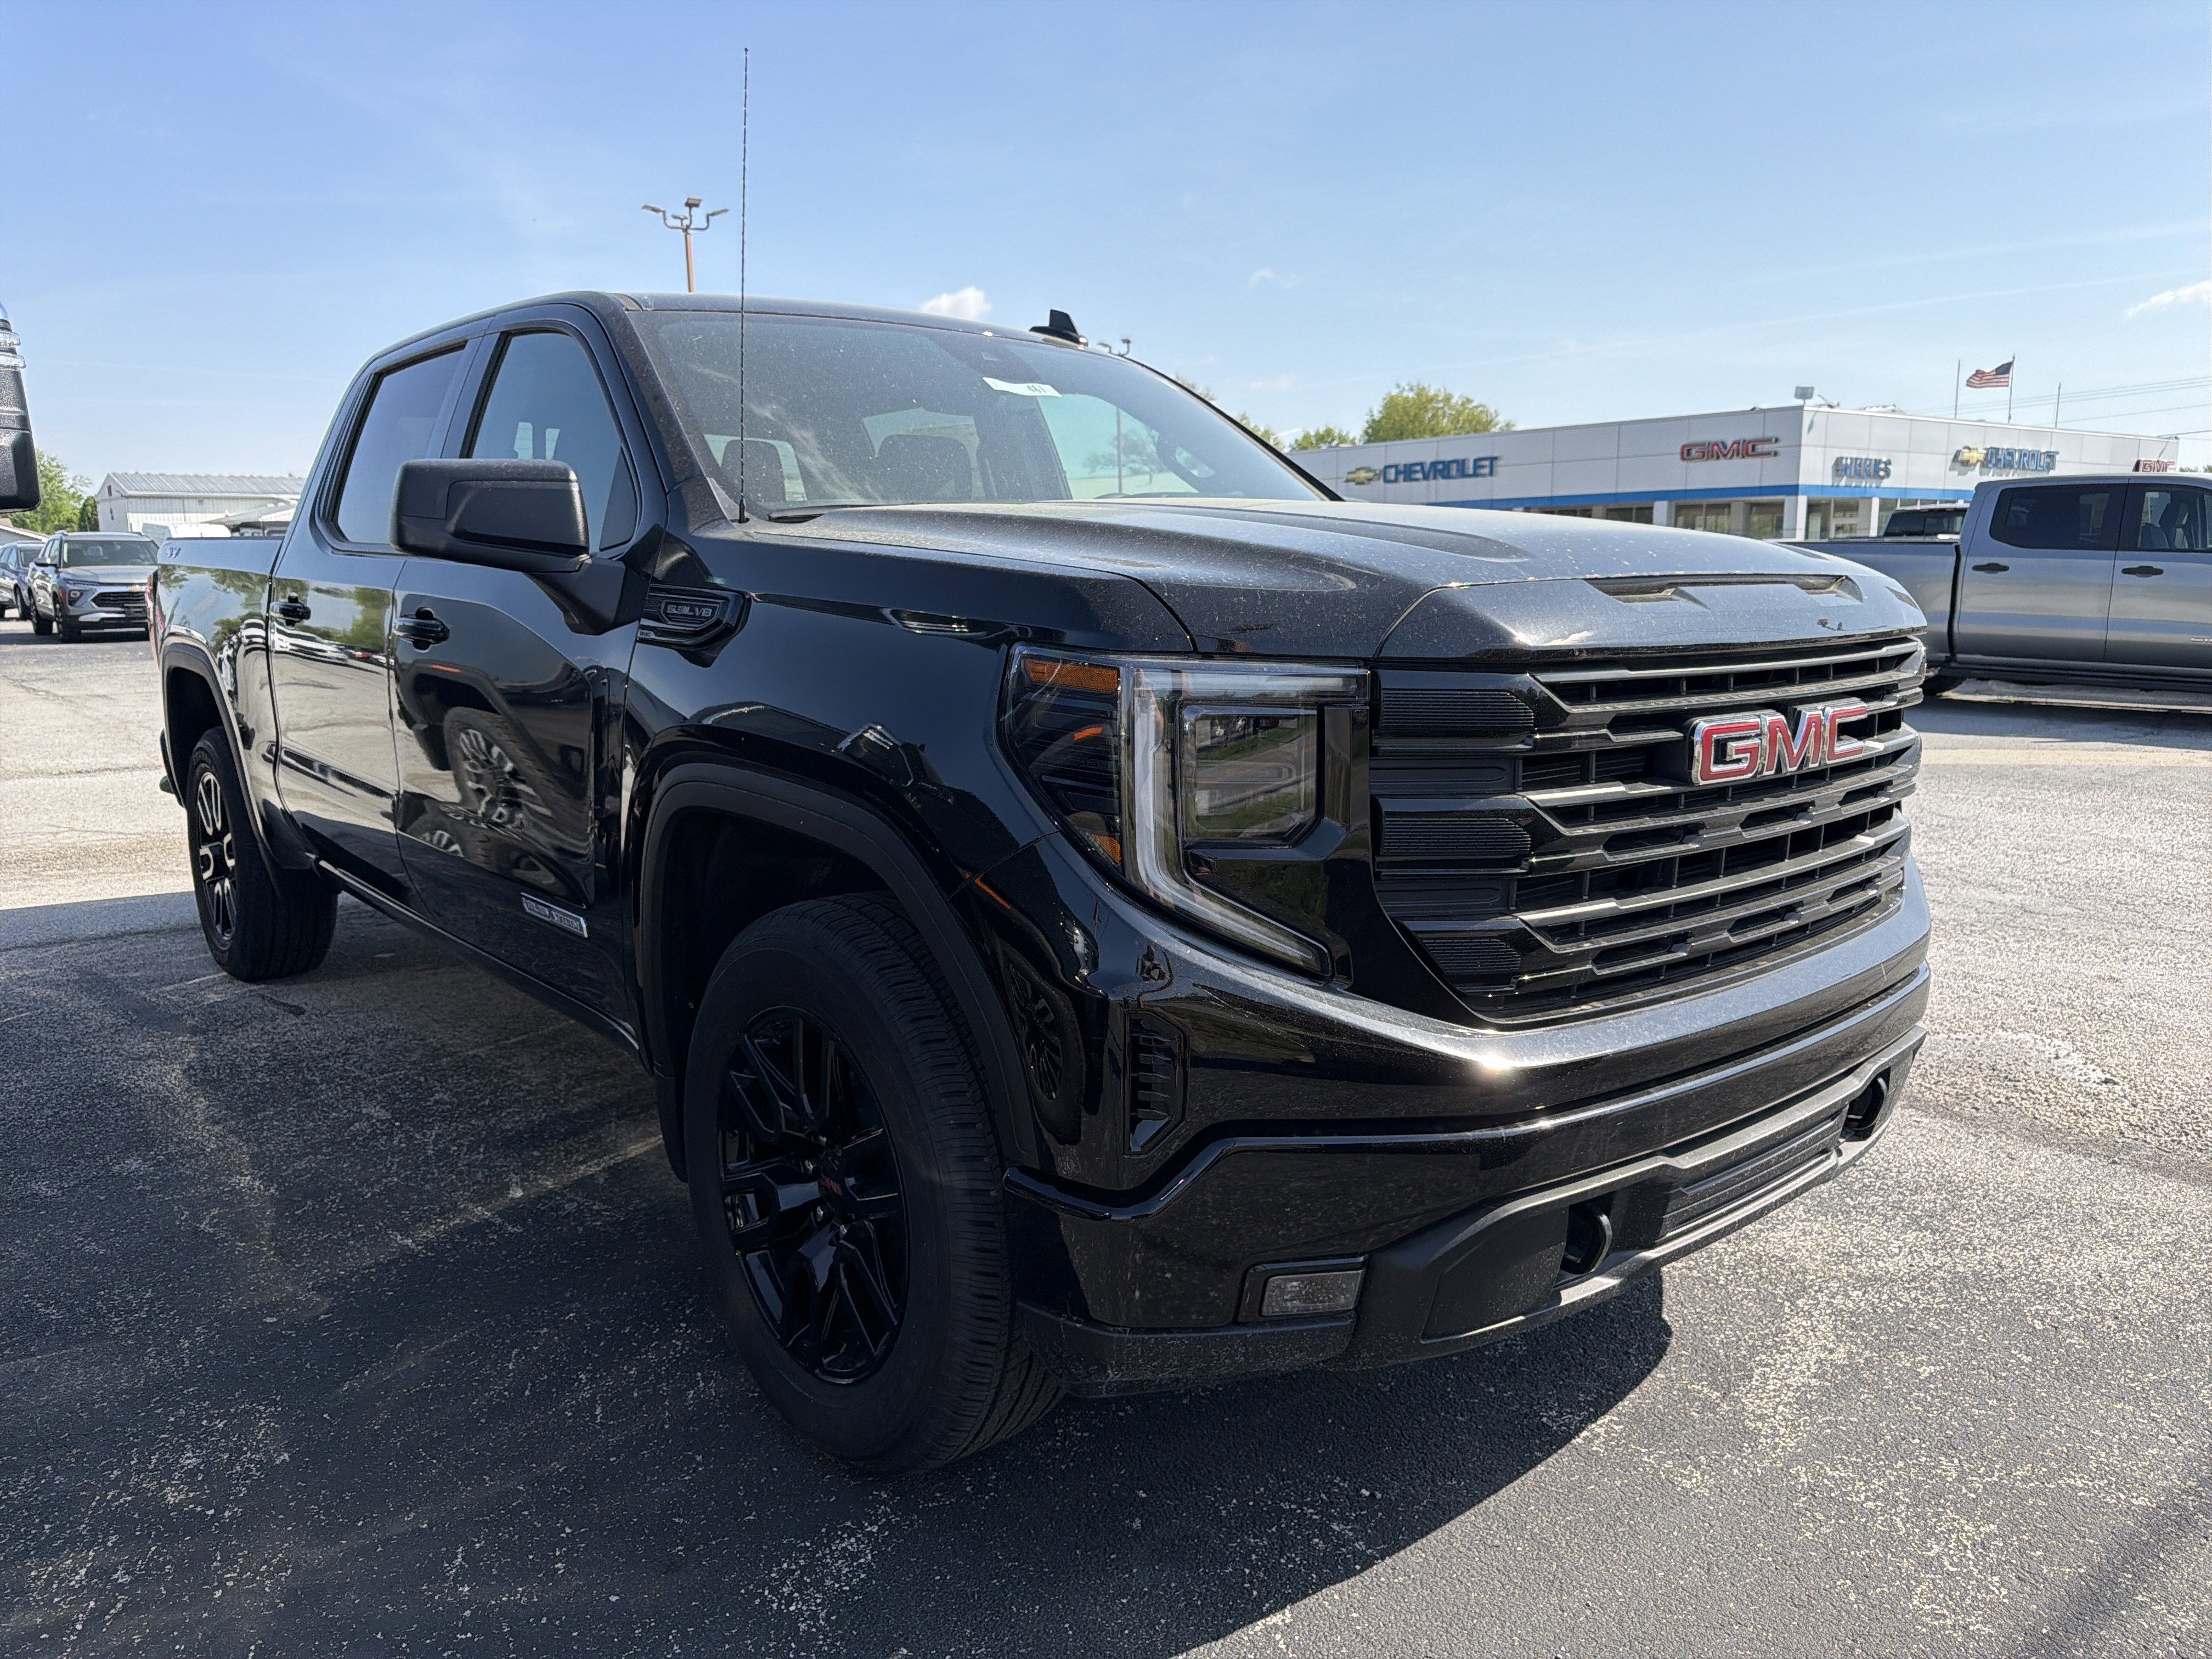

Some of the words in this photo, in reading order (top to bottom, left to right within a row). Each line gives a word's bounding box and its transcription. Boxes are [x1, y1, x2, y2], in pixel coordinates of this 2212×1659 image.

[1680, 437, 1778, 462] GMC
[1987, 447, 2059, 471] CHEVROLET
[1383, 456, 1498, 483] CHEVROLET
[1692, 699, 1867, 785] GMC
